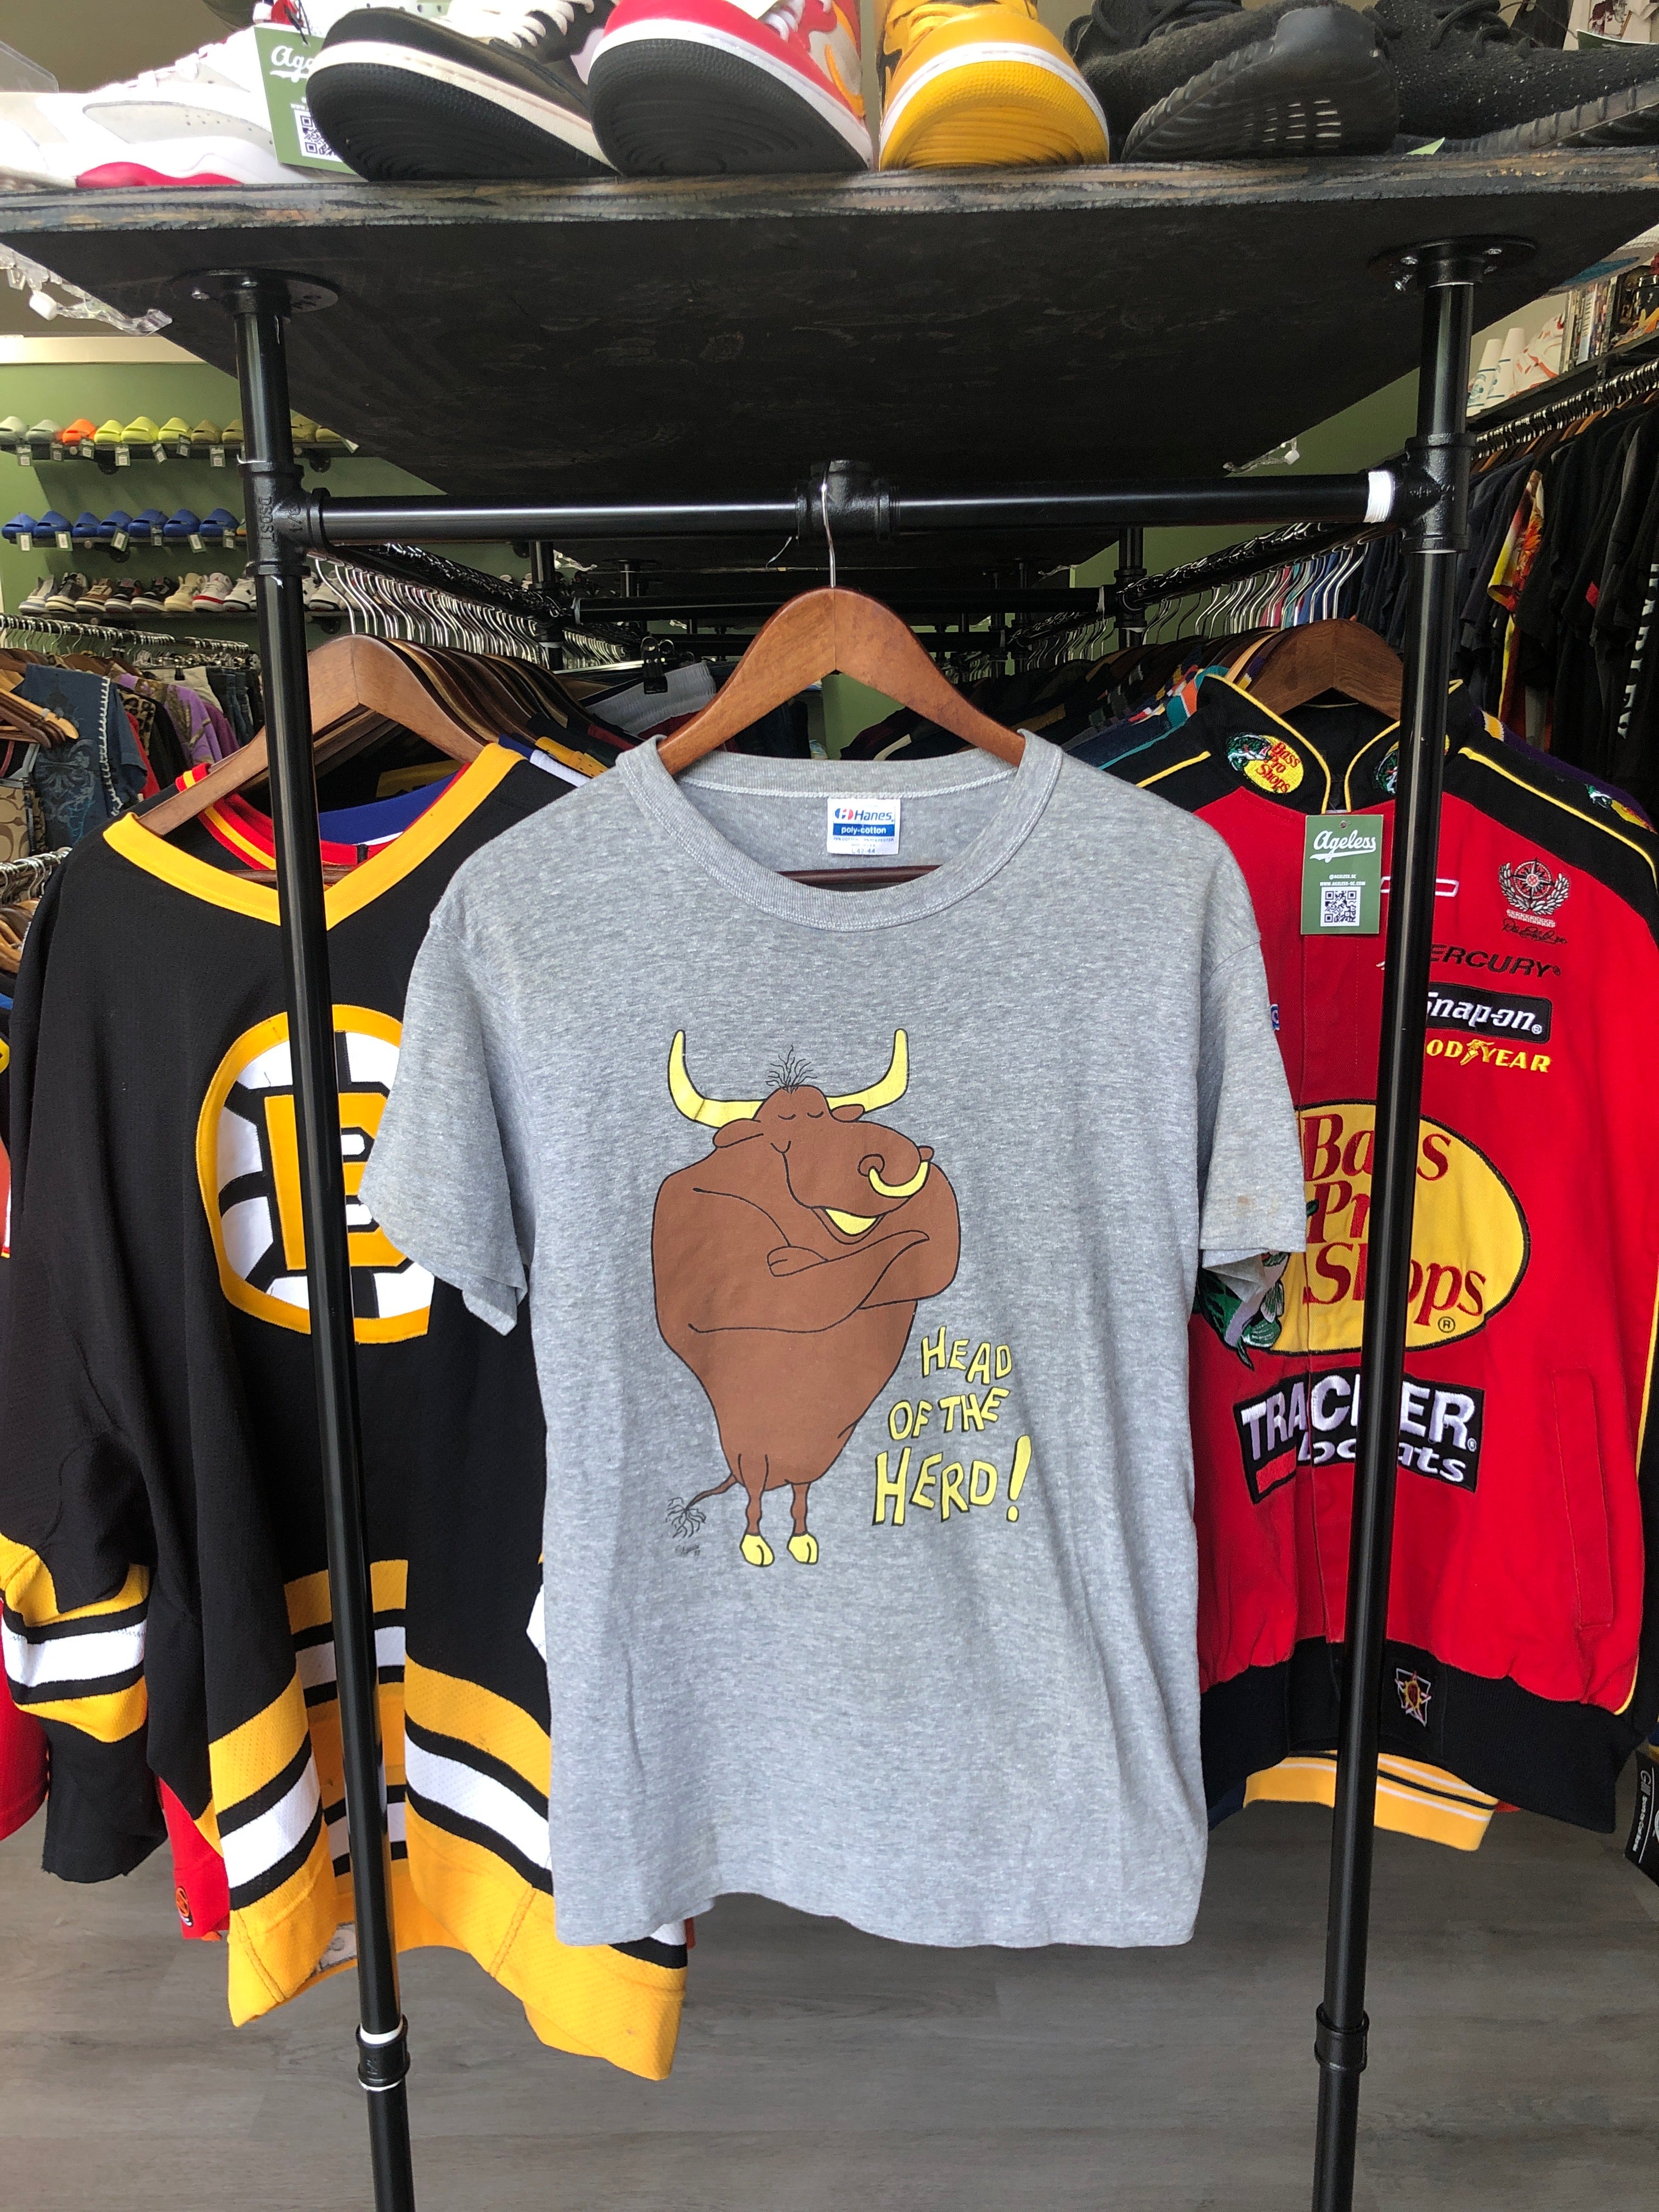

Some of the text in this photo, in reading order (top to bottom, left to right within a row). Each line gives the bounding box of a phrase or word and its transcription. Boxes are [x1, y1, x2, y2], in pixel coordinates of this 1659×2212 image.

[1271, 741, 1301, 768] Bass
[1256, 764, 1290, 793] Shops
[841, 825, 887, 835] poly-cotton
[854, 810, 893, 821] Hanes
[1310, 830, 1376, 863] Ageless
[1430, 944, 1551, 978] ERCURY
[1426, 1039, 1552, 1073] ODYEAR
[1302, 1113, 1452, 1181] Bas
[1306, 1180, 1371, 1244] Pr
[921, 1325, 1013, 1385] HEAD
[888, 1387, 1011, 1441] OF THE
[1241, 1373, 1476, 1462] TRACER
[872, 1435, 1032, 1526] HERD!
